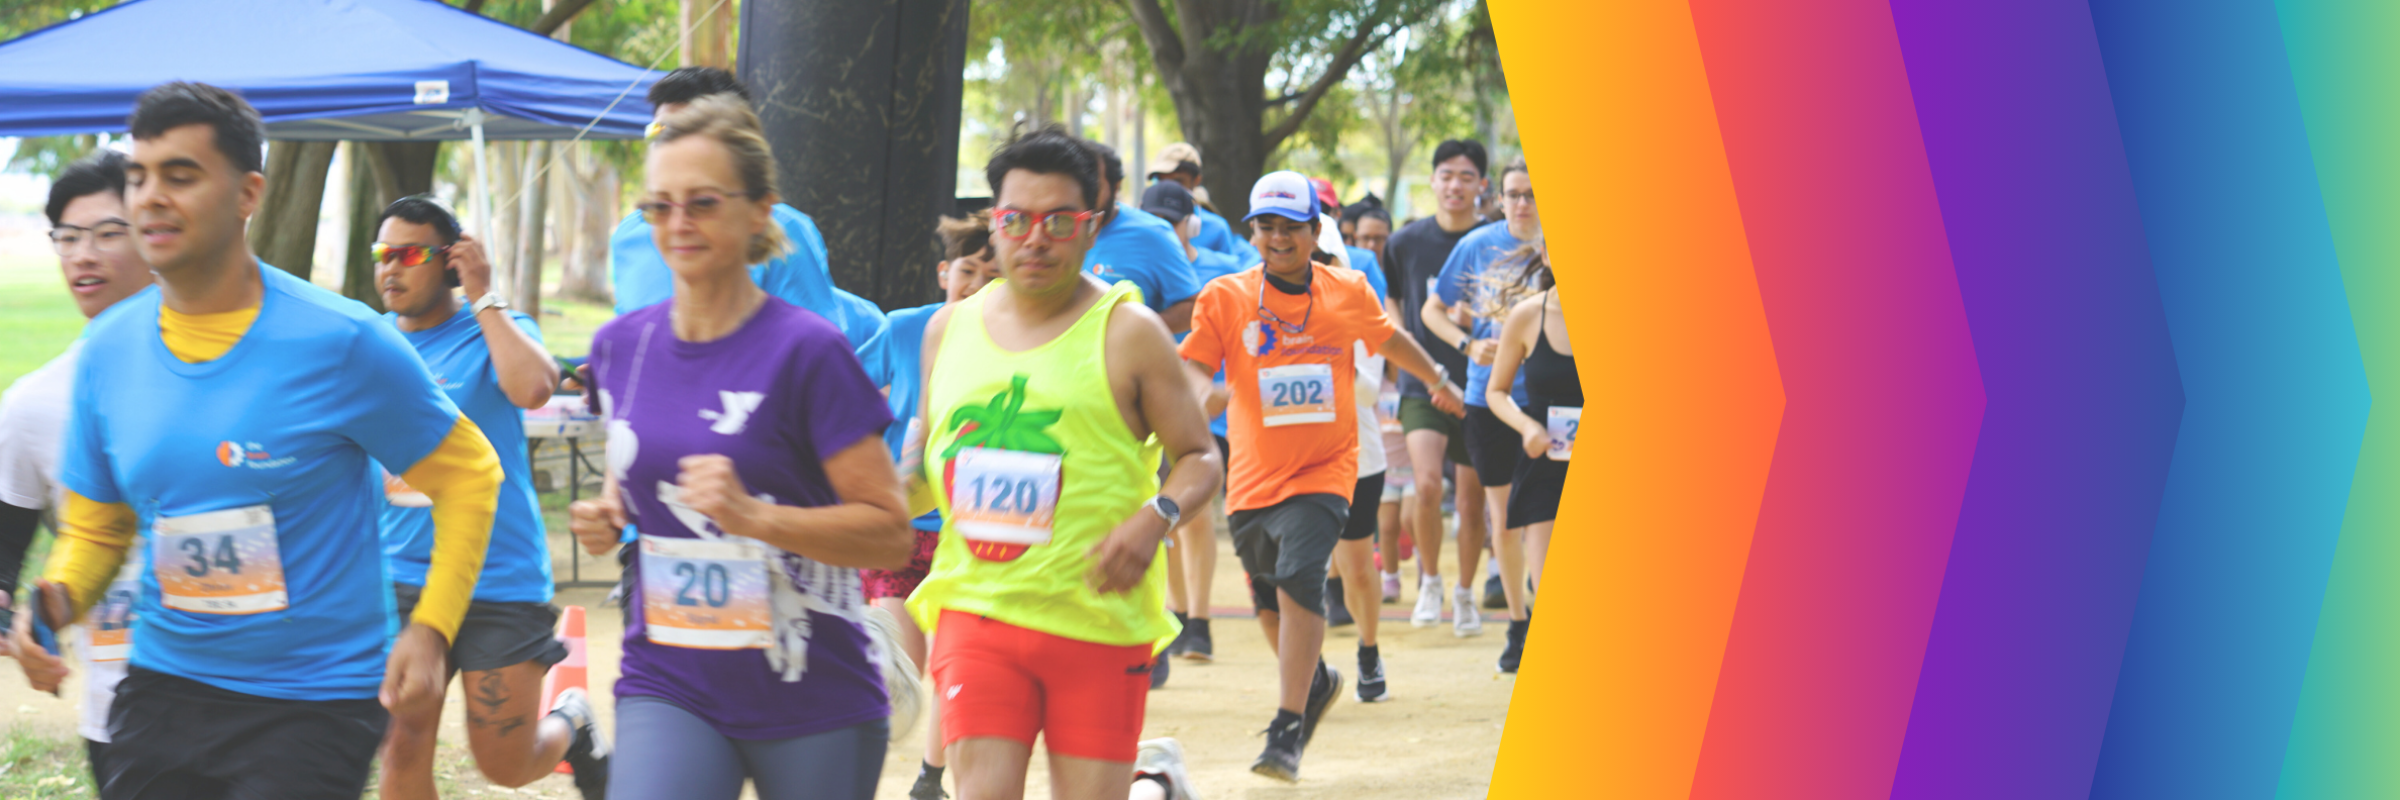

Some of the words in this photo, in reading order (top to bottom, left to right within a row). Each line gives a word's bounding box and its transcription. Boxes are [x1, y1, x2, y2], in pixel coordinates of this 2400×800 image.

[1271, 380, 1323, 407] 202
[972, 474, 1037, 514] 120
[178, 535, 242, 577] 34
[675, 562, 729, 608] 20
